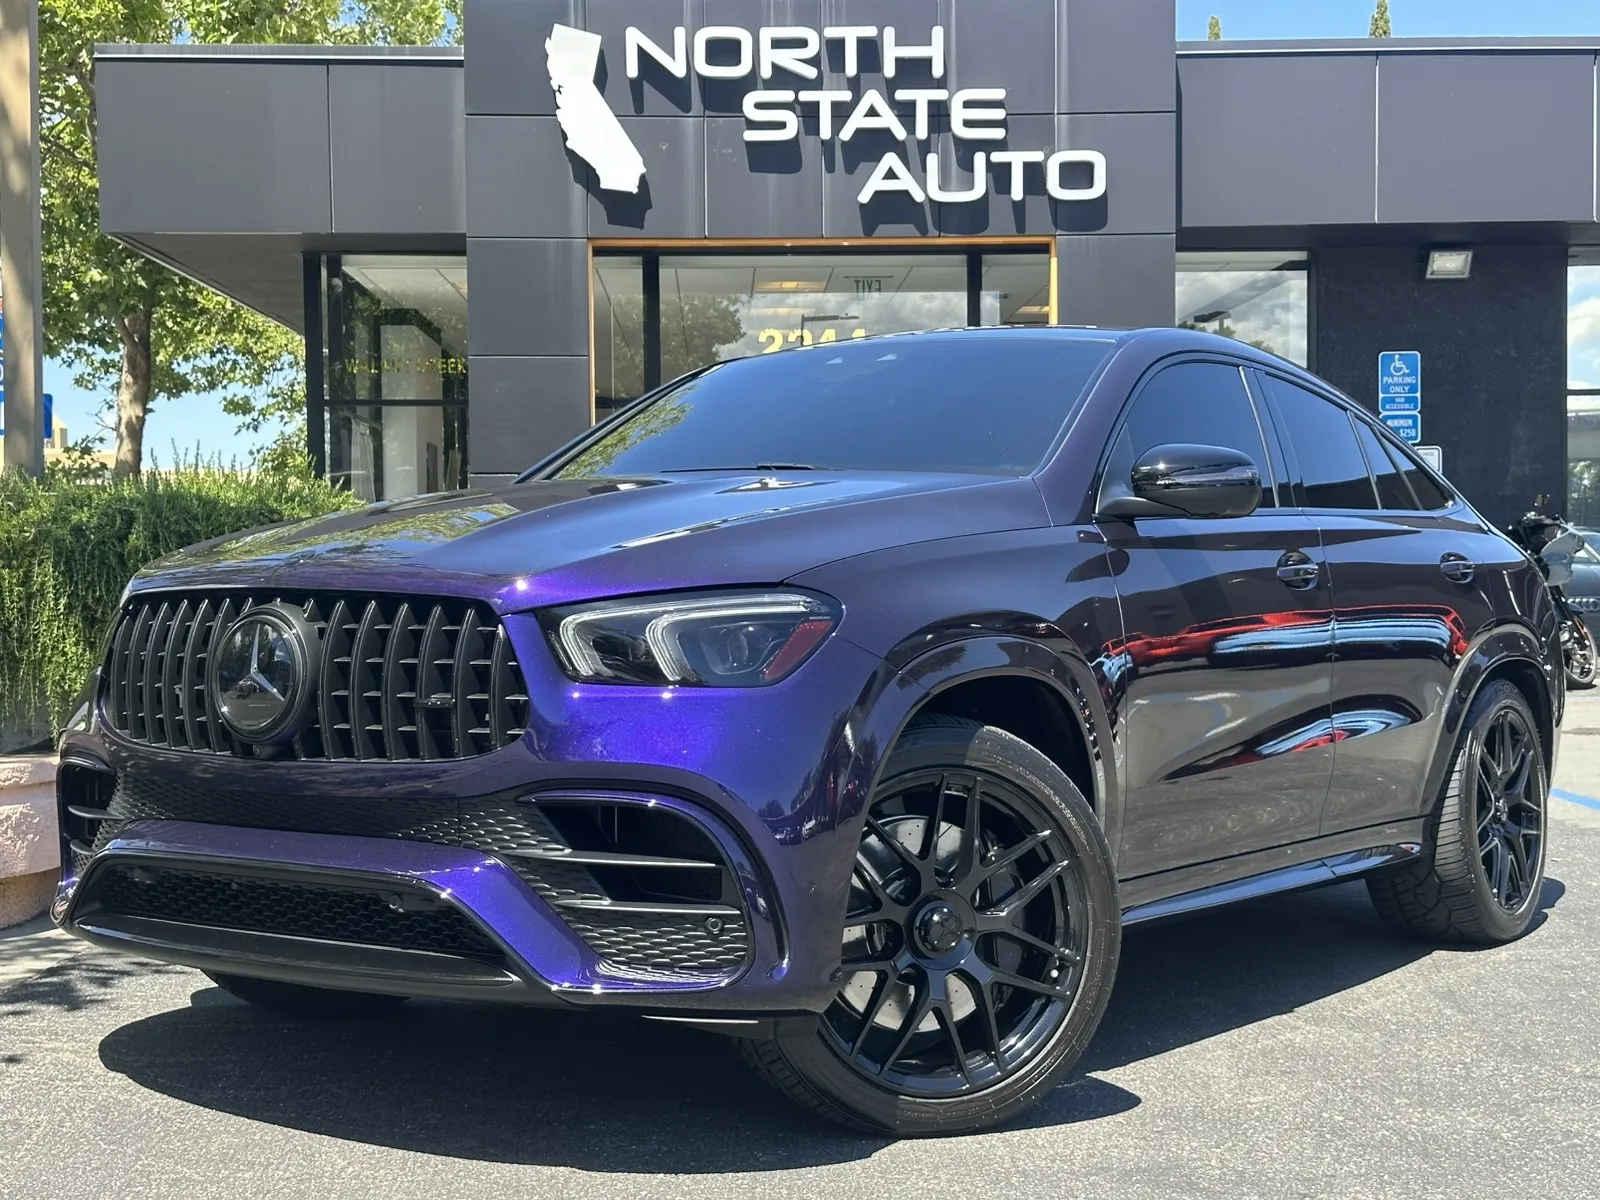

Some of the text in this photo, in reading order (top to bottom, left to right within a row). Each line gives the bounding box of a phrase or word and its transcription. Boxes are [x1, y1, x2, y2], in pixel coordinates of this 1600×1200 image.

[625, 25, 945, 80] NORTH
[742, 88, 1007, 142] STATE
[857, 149, 1107, 204] AUTO
[1383, 376, 1416, 384] PARKING
[1389, 385, 1410, 393] ONLY
[1399, 428, 1416, 437] $250
